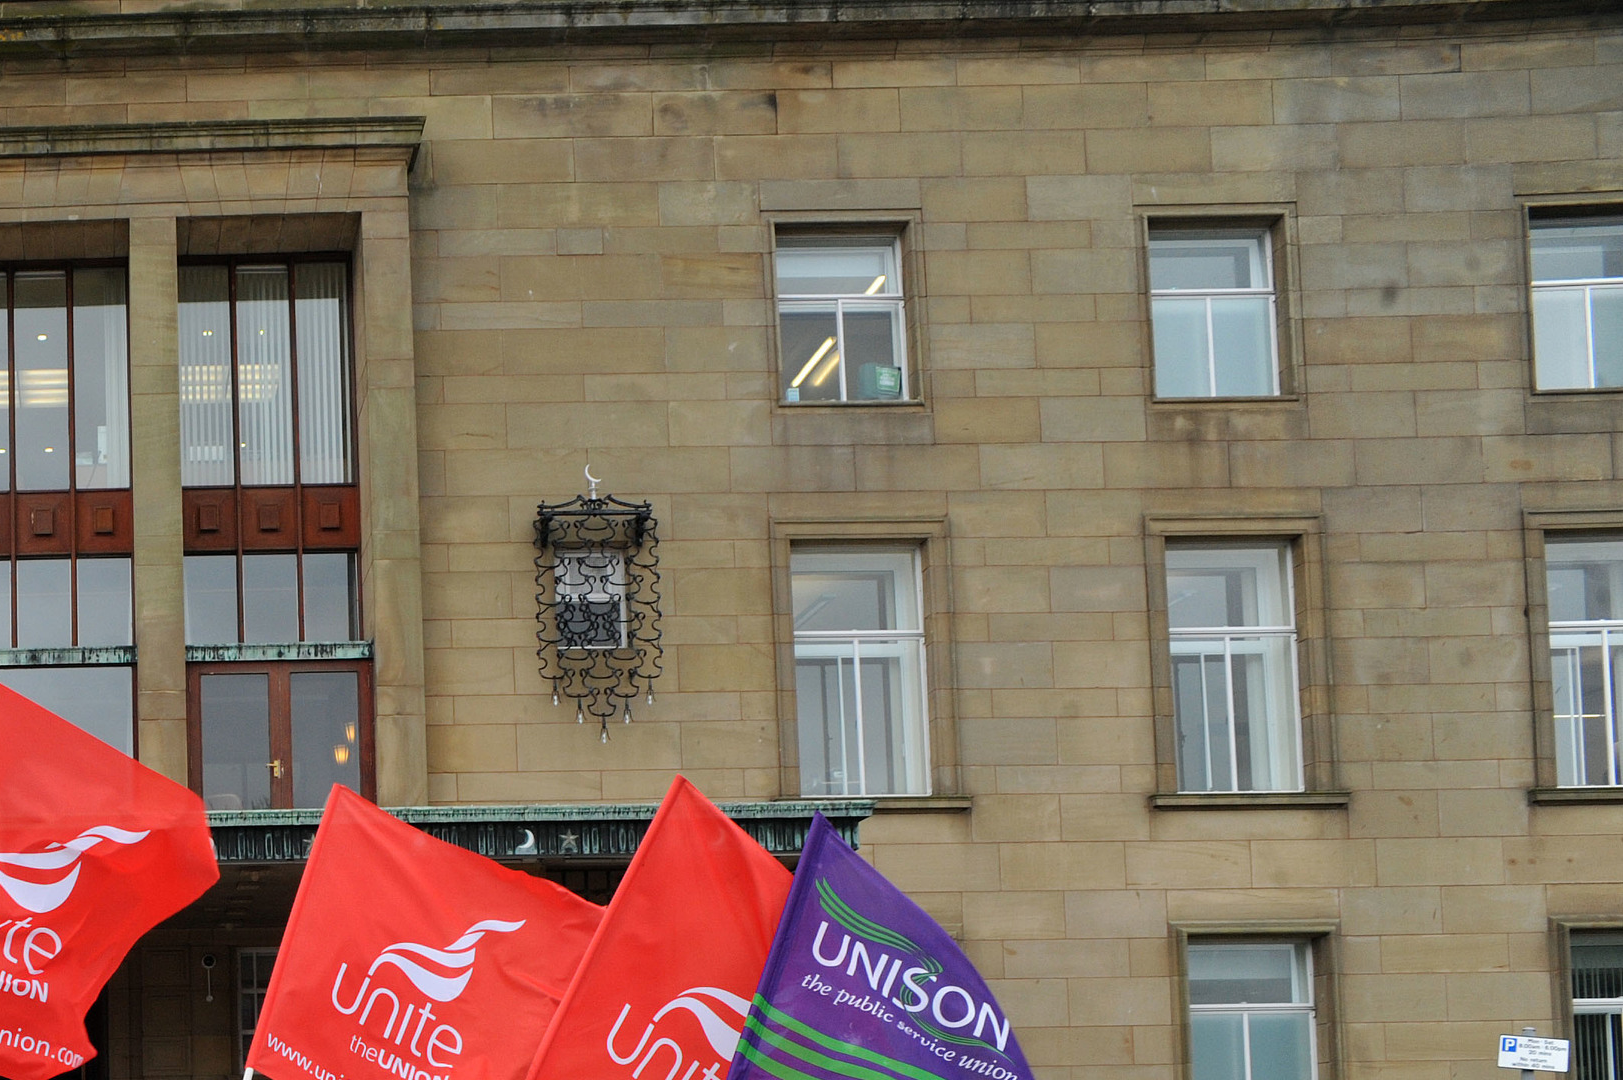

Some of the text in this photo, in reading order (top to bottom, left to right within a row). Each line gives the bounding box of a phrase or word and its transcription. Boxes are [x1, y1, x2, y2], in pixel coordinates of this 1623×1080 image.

[800, 972, 832, 997] the
[834, 989, 894, 1025] public
[896, 1018, 957, 1062] service
[812, 921, 1011, 1053] UNISON
